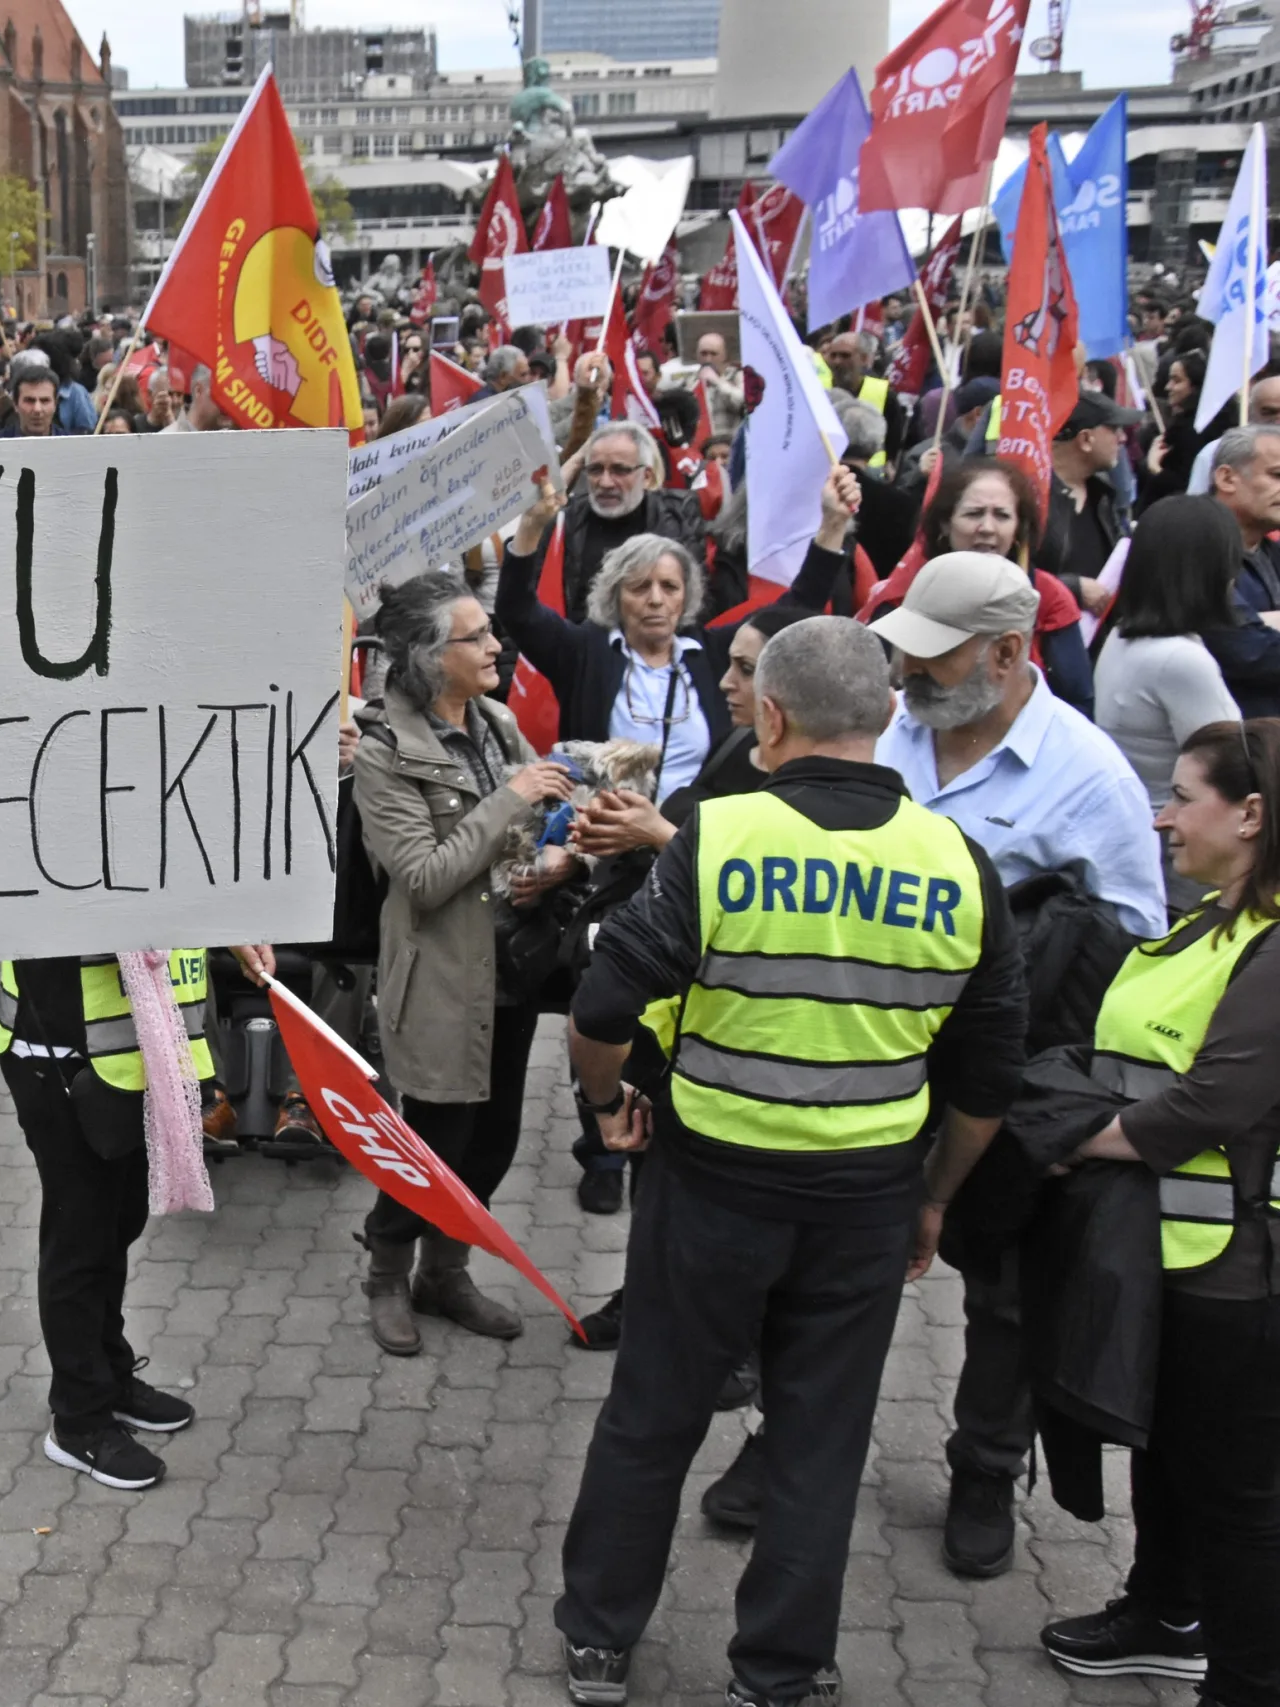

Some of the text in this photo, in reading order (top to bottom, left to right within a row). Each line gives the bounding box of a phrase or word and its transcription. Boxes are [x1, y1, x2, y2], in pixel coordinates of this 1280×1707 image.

[289, 299, 338, 366] DIDF
[223, 379, 275, 429] SIND
[389, 436, 431, 458] keine
[717, 856, 962, 936] ORDNER
[321, 1087, 431, 1188] CHP
